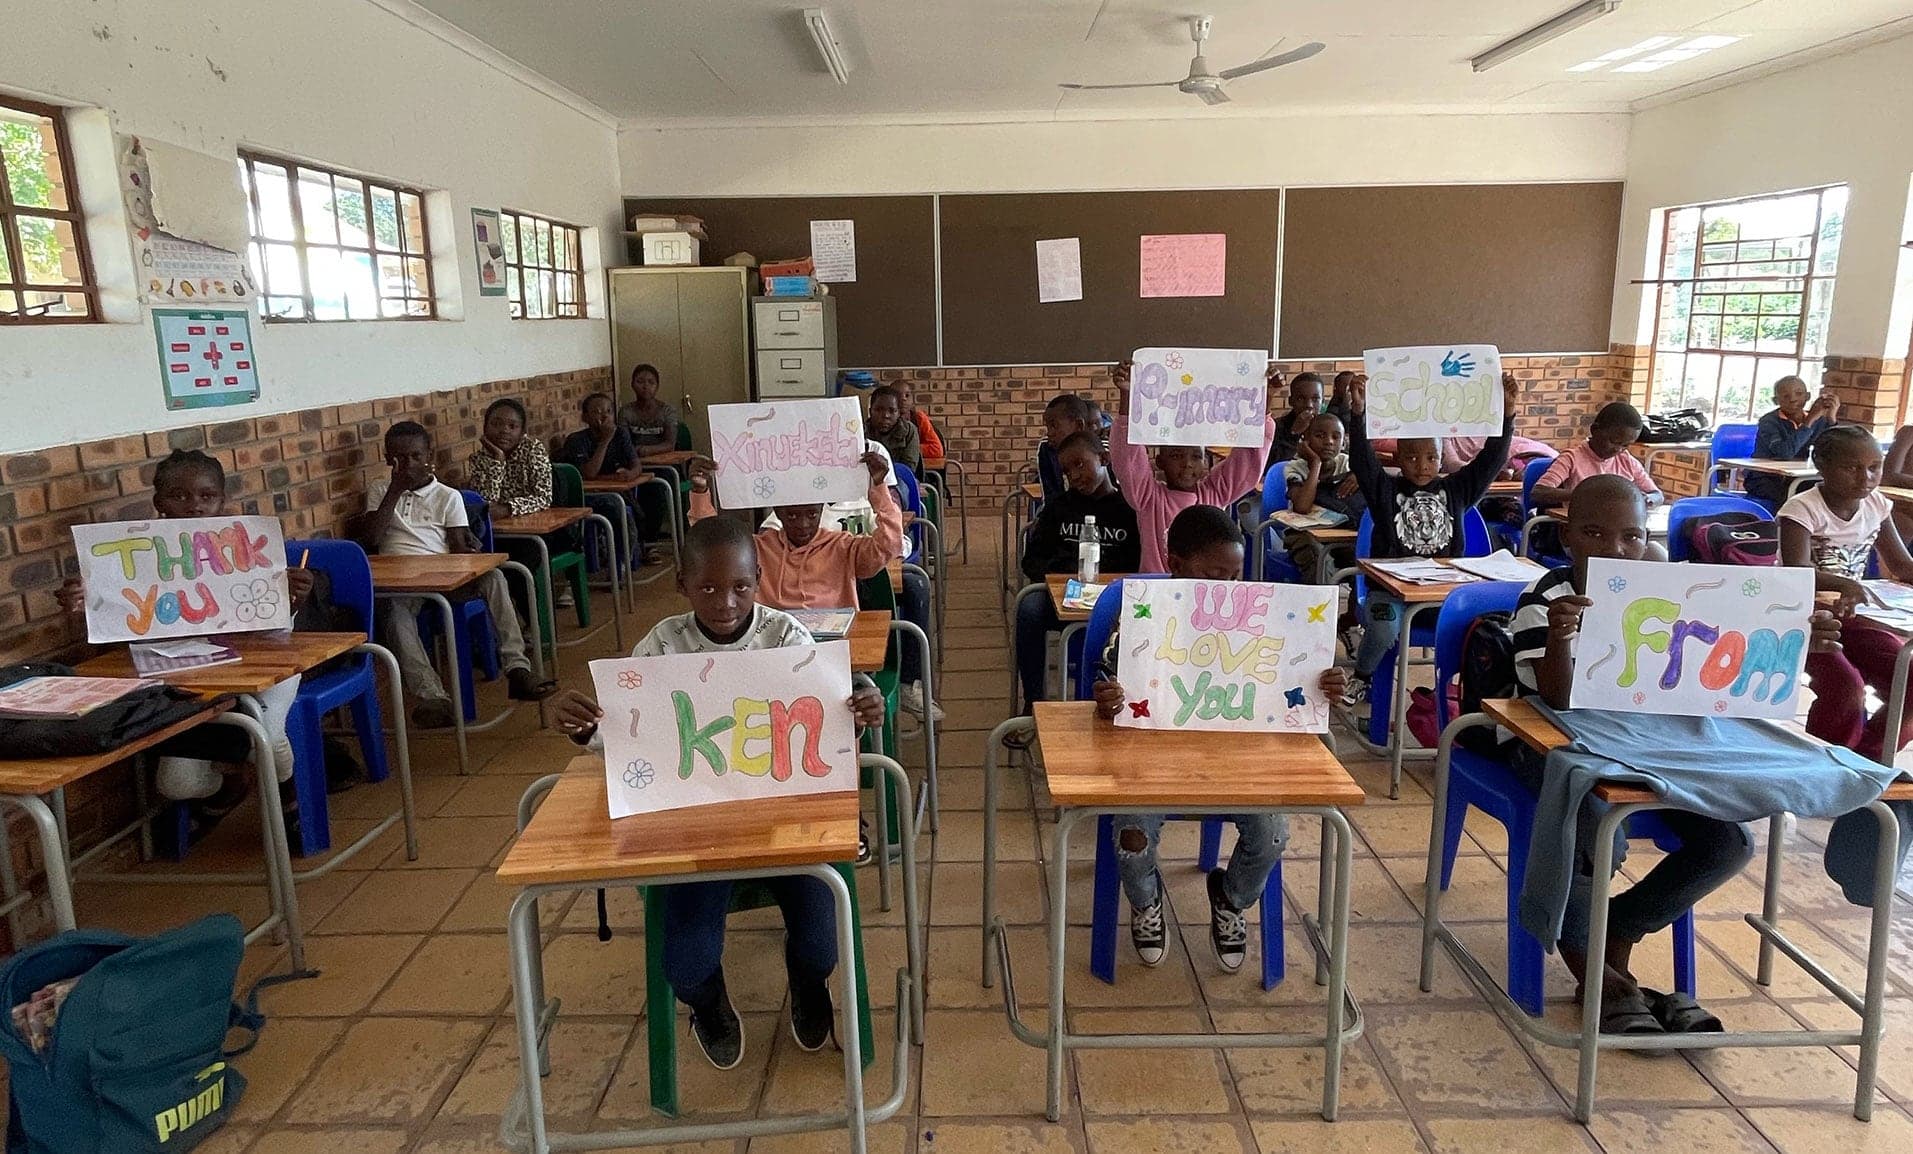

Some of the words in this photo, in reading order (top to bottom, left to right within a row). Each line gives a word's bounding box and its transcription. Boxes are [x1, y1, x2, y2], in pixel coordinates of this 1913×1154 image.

[1132, 361, 1266, 428] Primary
[1060, 522, 1128, 541] MIANO
[1191, 583, 1275, 636] WE
[1155, 616, 1285, 684] LOVE
